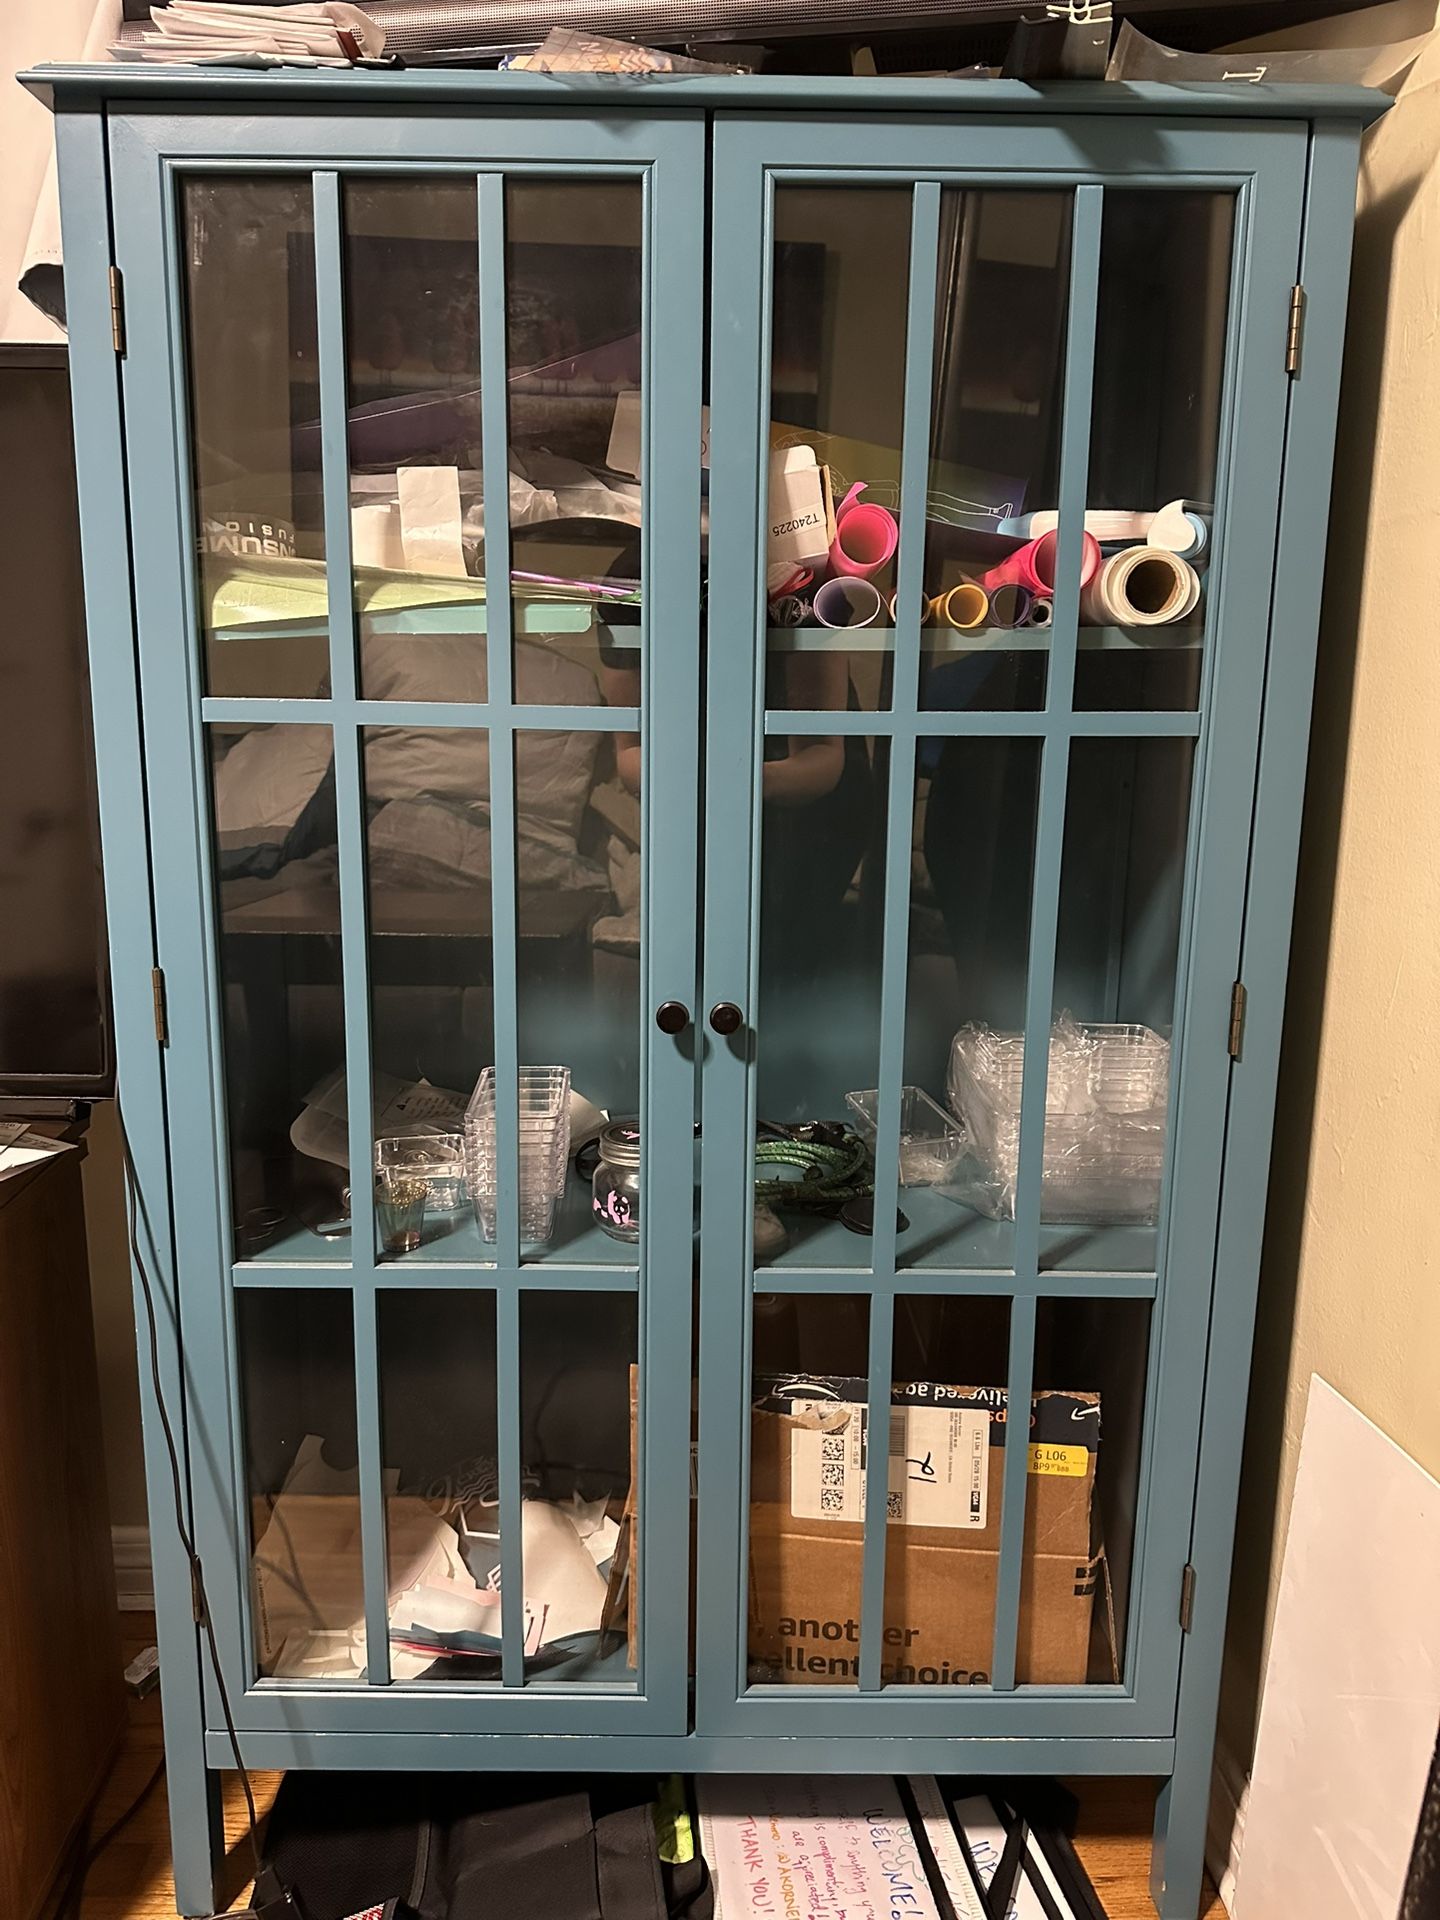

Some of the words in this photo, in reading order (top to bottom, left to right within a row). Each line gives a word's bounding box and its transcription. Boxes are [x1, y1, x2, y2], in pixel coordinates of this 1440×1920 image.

[772, 513, 820, 537] T240225
[1034, 1449, 1042, 1460] G
[1046, 1450, 1067, 1461] L06
[778, 1617, 920, 1647] anoter
[737, 1815, 764, 1873] THANK
[792, 1831, 805, 1847] are
[862, 1808, 924, 1920] WELCOME!
[748, 1877, 776, 1914] YOU!
[776, 1851, 801, 1920] @AKORNE
